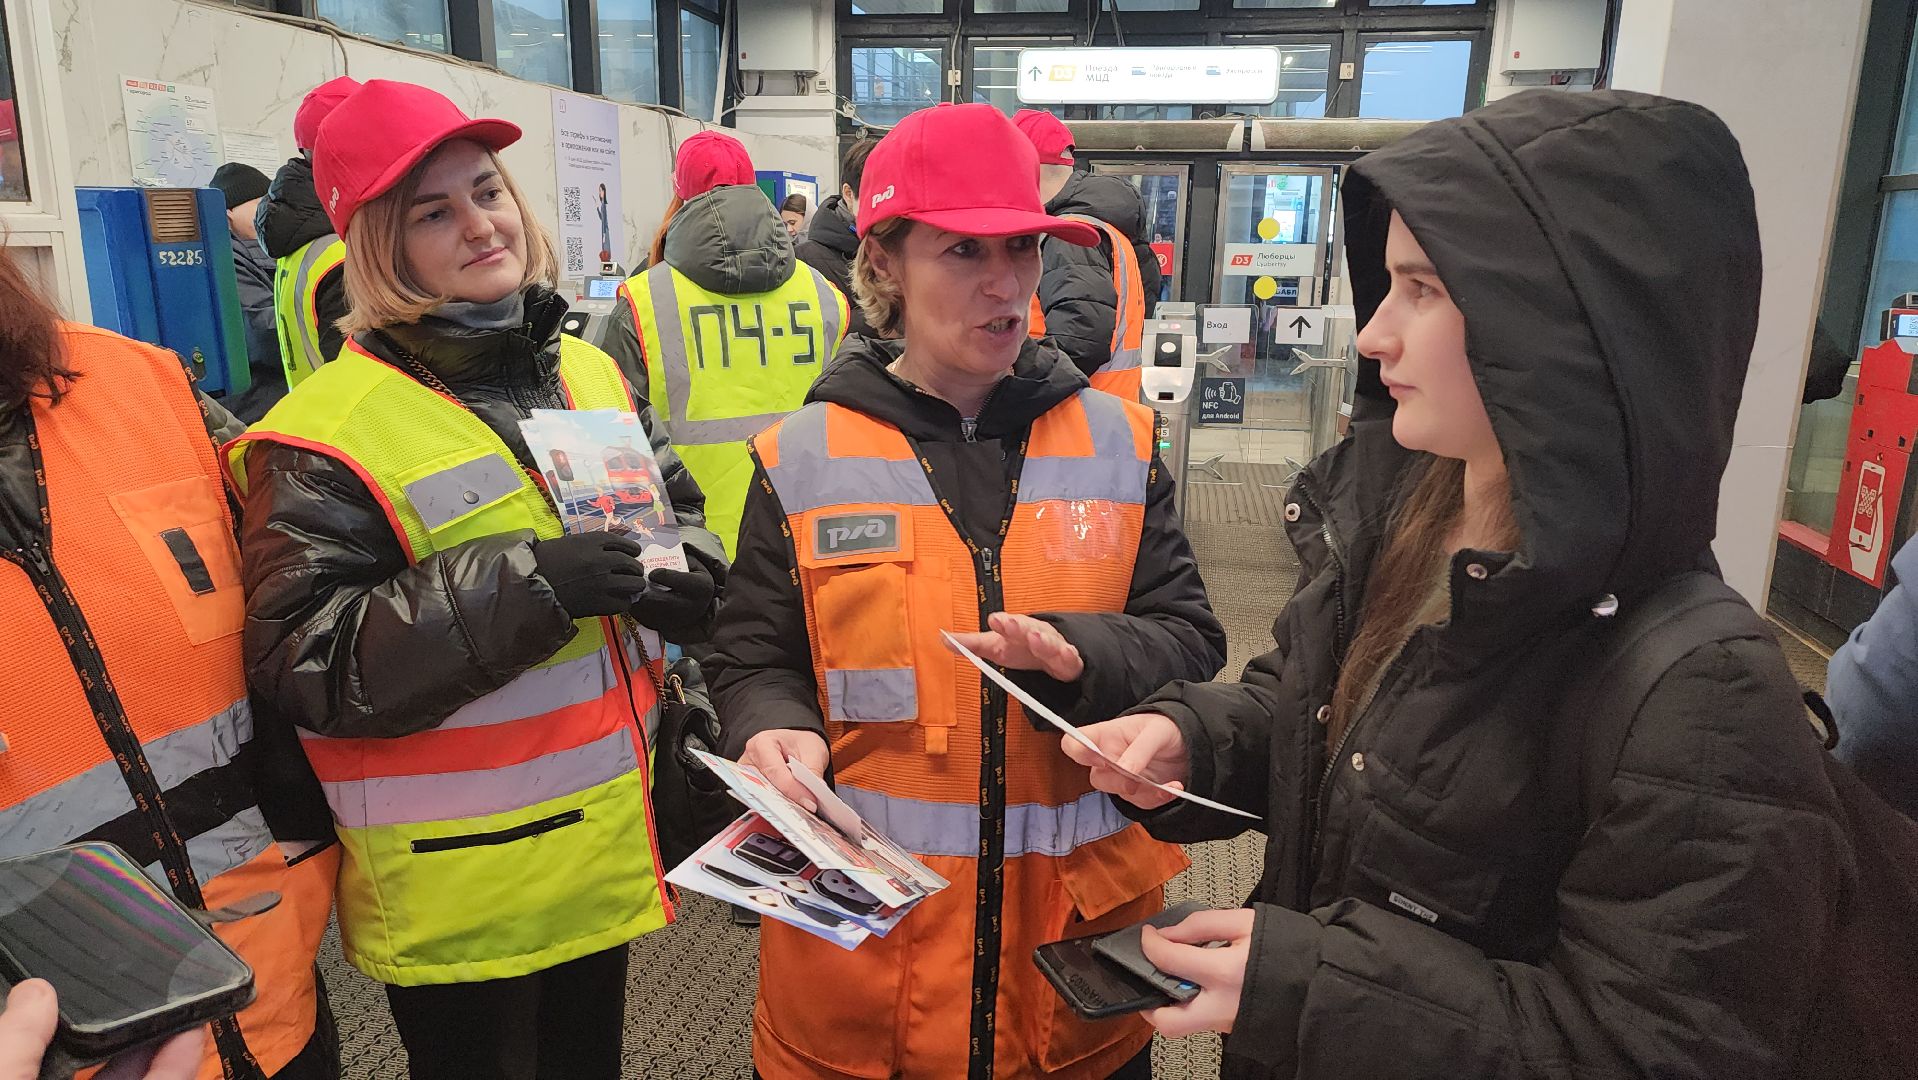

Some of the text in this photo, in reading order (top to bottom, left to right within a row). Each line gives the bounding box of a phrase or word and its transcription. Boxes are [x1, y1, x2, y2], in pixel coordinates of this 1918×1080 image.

[1085, 64, 1118, 73] Поезда
[1085, 74, 1110, 83] МЦД
[159, 249, 203, 265] 52285
[1235, 256, 1251, 265] D3
[1257, 252, 1296, 261] Люберцы
[1256, 260, 1287, 268] Lyubertsy
[1206, 321, 1228, 329] Вход
[1202, 402, 1219, 410] NFC
[1215, 412, 1240, 420] Android
